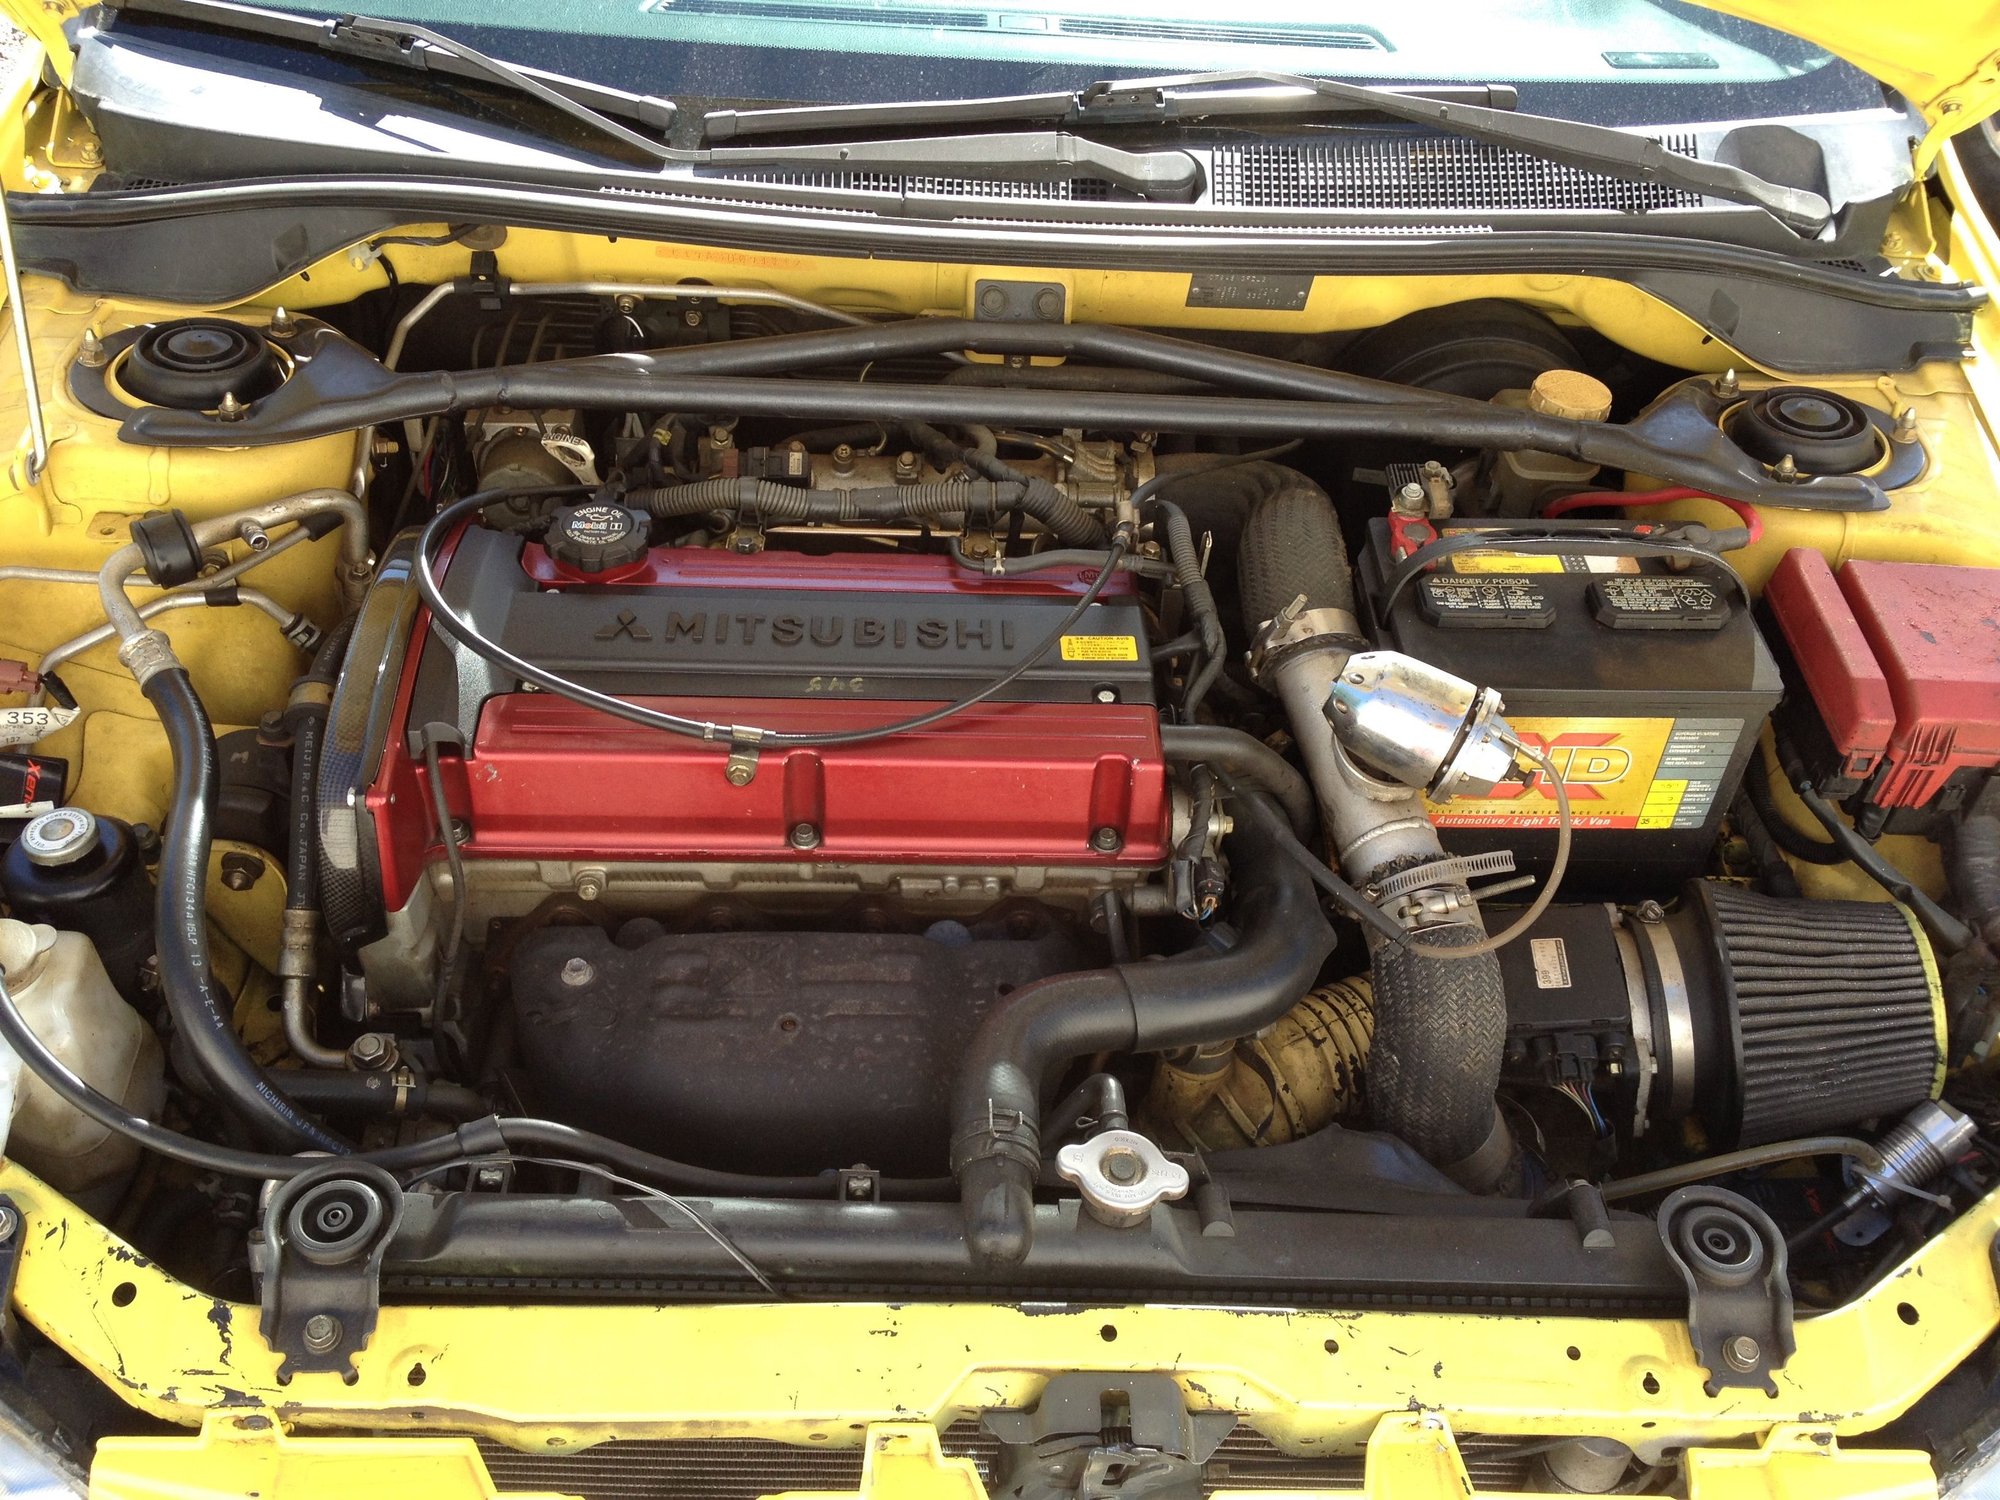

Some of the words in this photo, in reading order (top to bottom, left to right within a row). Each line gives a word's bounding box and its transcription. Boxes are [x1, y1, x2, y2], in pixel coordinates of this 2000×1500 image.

[574, 506, 609, 517] ENGINE
[611, 508, 624, 519] OIL
[571, 521, 607, 530] Mobil
[665, 611, 1015, 648] MITSUBISHI
[7, 711, 49, 725] 353
[303, 731, 314, 768] MEIJI
[23, 758, 41, 804] Xen
[1436, 815, 1512, 825] Automotive/
[1513, 816, 1544, 827] Light
[1589, 817, 1612, 825] Van
[297, 840, 308, 881] JAPAN
[190, 954, 203, 967] 13
[1541, 970, 1552, 985] 399
[256, 1081, 294, 1119] NICHIRIN
